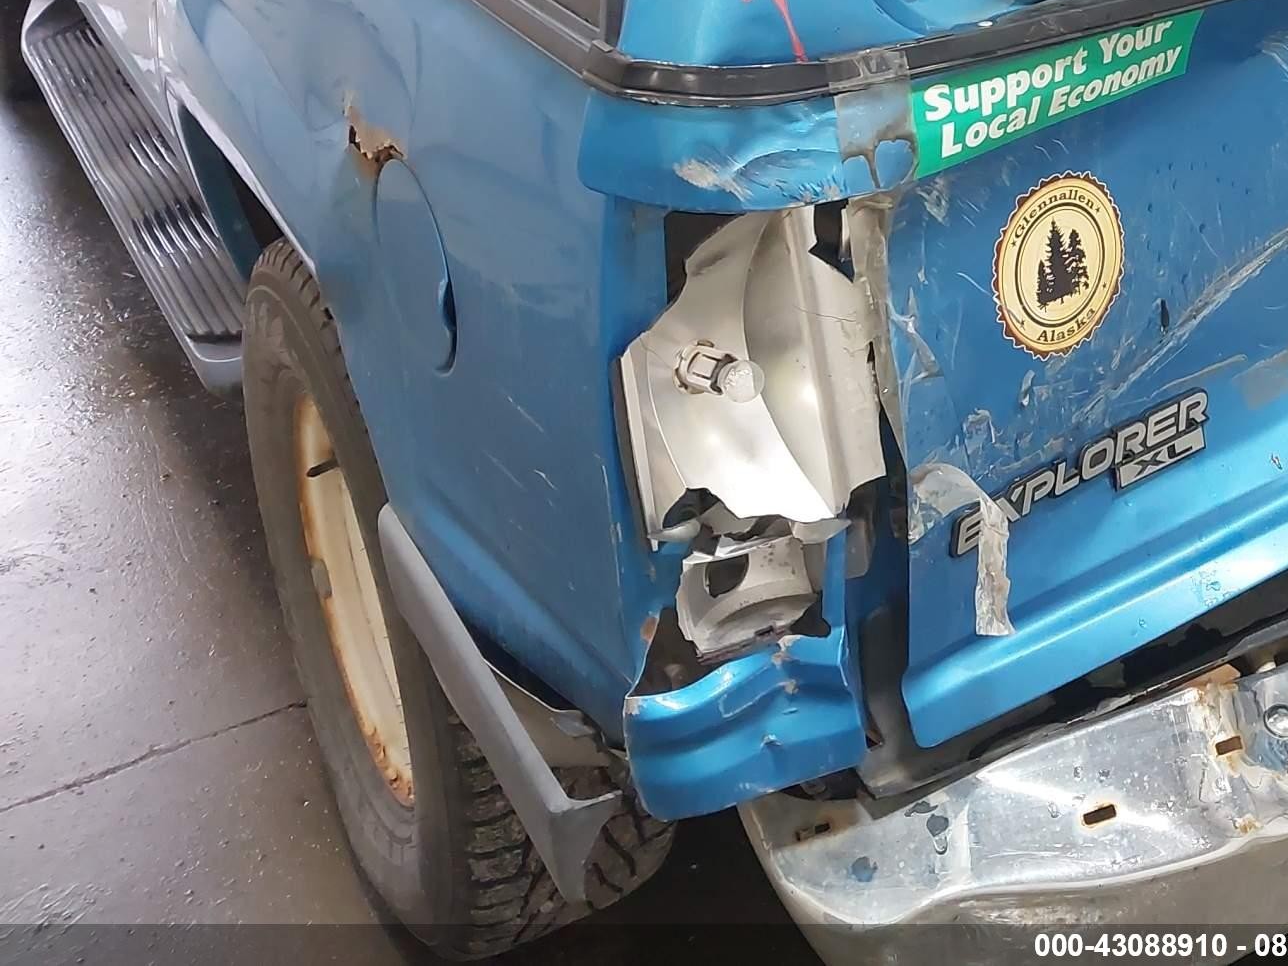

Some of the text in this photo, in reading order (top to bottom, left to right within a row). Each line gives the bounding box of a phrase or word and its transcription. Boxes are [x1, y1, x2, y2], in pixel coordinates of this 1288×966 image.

[923, 20, 1173, 122] Support Your
[941, 45, 1182, 159] Local Economy
[1014, 189, 1095, 241] Glennallen
[1036, 307, 1096, 343] Alaska
[1130, 436, 1196, 482] XL
